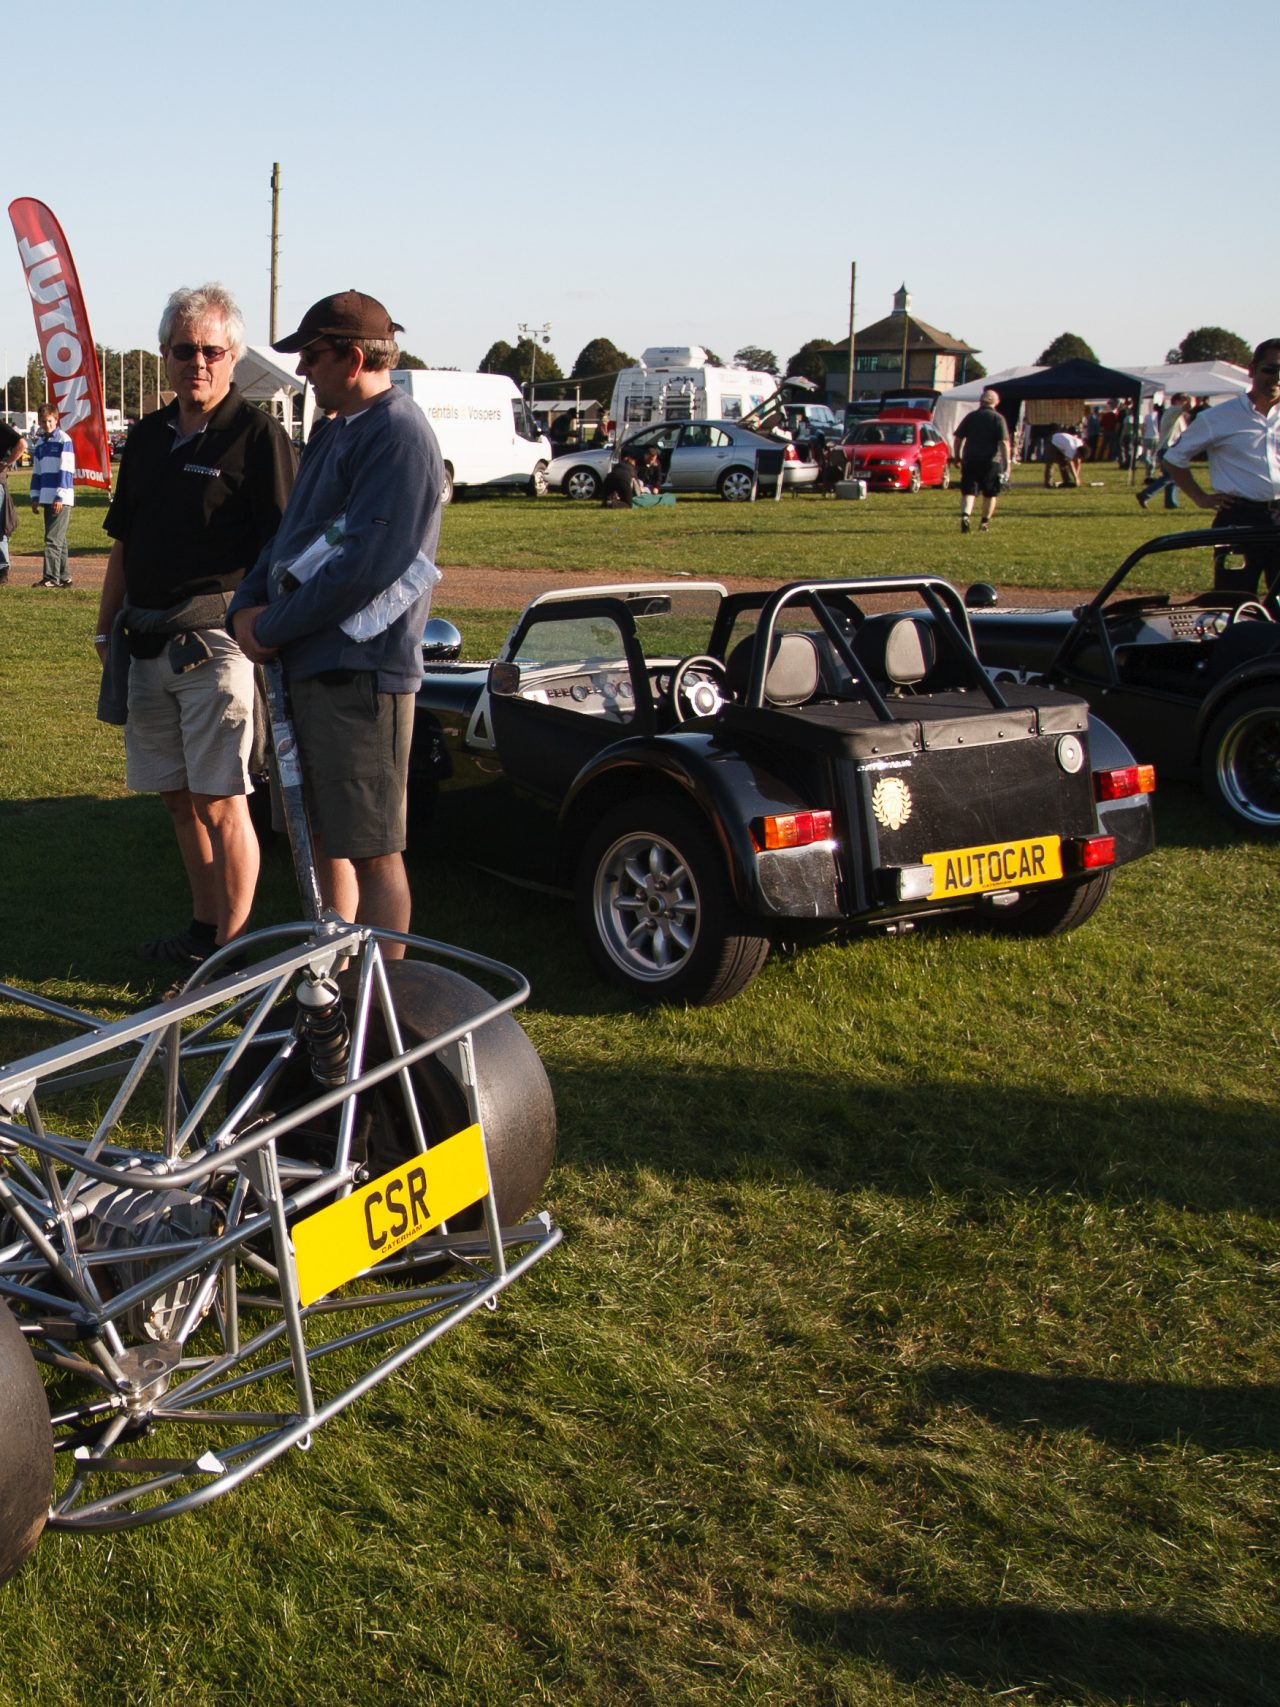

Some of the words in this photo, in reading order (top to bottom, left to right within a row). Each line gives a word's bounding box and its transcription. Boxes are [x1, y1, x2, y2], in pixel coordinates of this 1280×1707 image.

[428, 404, 460, 420] rentals
[467, 406, 502, 422] Vospers
[944, 844, 1046, 891] AUTOCAR
[364, 1167, 431, 1251] CSR
[380, 1224, 423, 1254] CATERHAM
